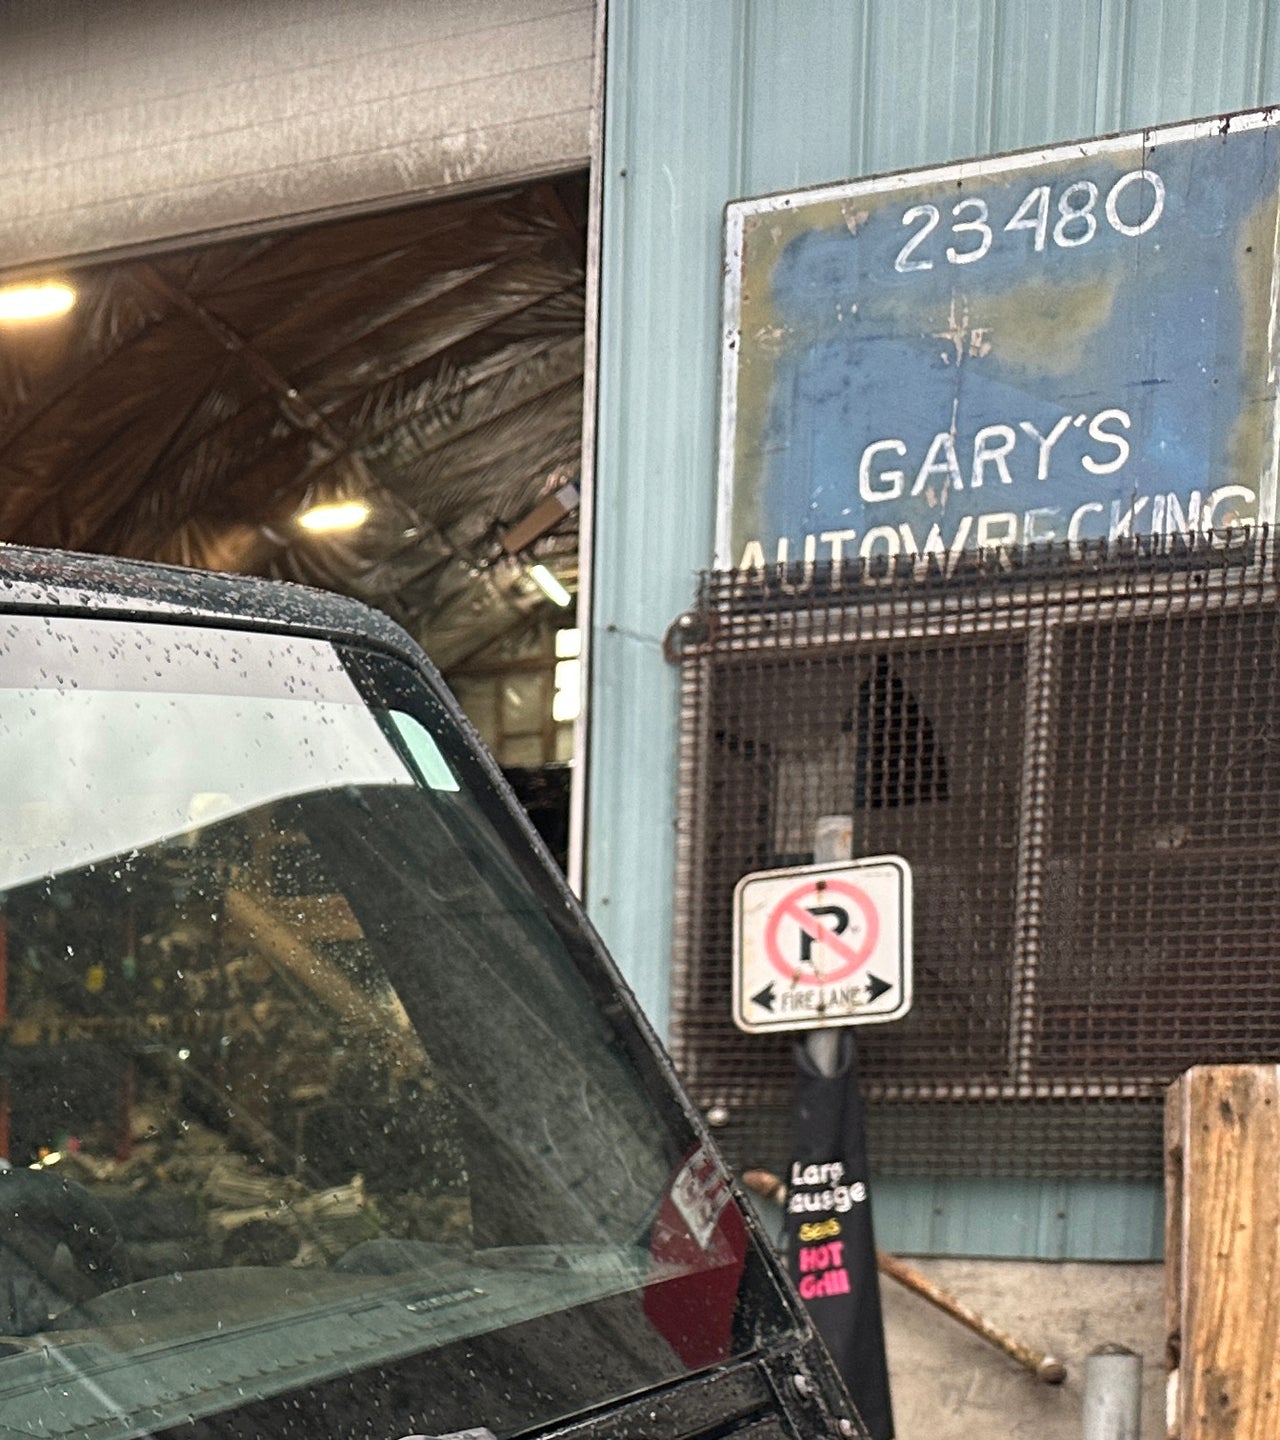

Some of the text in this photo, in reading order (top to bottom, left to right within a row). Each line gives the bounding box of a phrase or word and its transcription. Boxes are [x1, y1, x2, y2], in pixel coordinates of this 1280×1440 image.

[894, 169, 1168, 274] 23480
[858, 408, 1132, 503] GARY'S
[781, 986, 865, 1012] FIRE LANE
[799, 1241, 844, 1272] HOT
